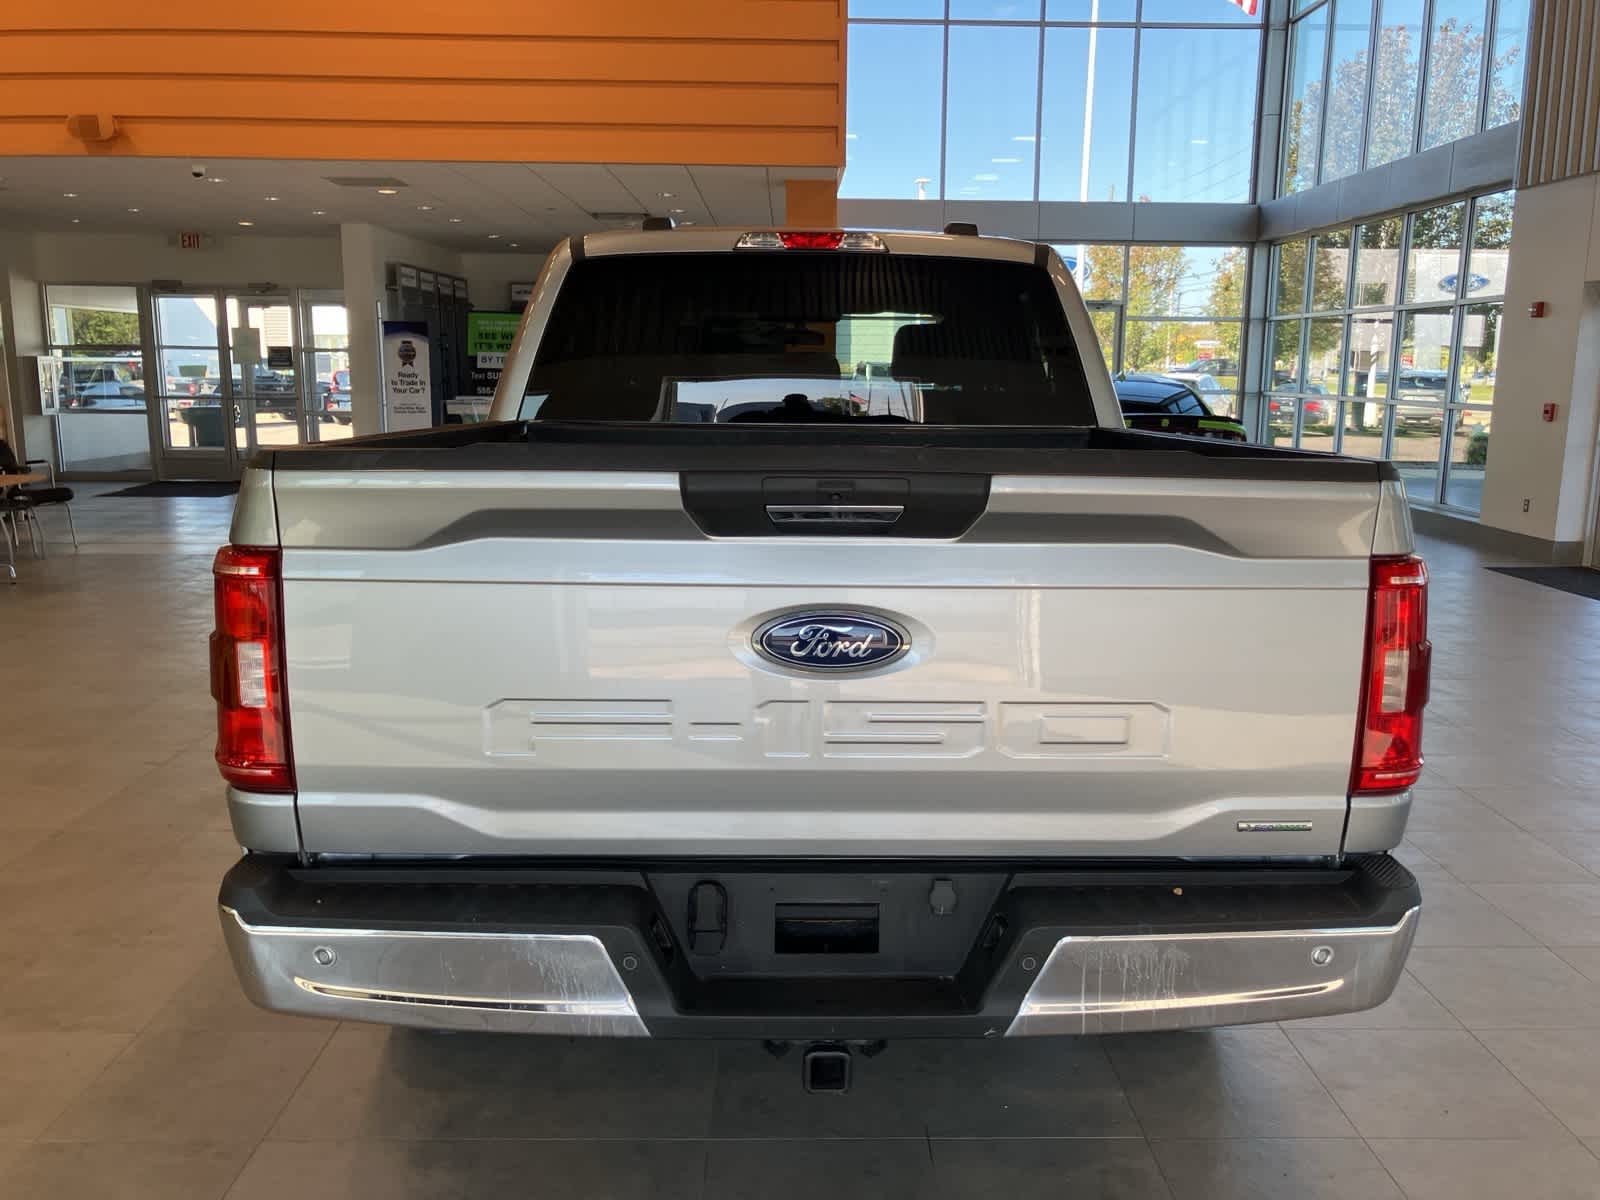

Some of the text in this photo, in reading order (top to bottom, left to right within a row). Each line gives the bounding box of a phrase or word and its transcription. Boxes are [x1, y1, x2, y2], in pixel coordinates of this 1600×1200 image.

[181, 231, 200, 249] EXIT
[397, 371, 418, 379] Ready
[790, 624, 873, 658] Ford
[482, 698, 1171, 759] F-150
